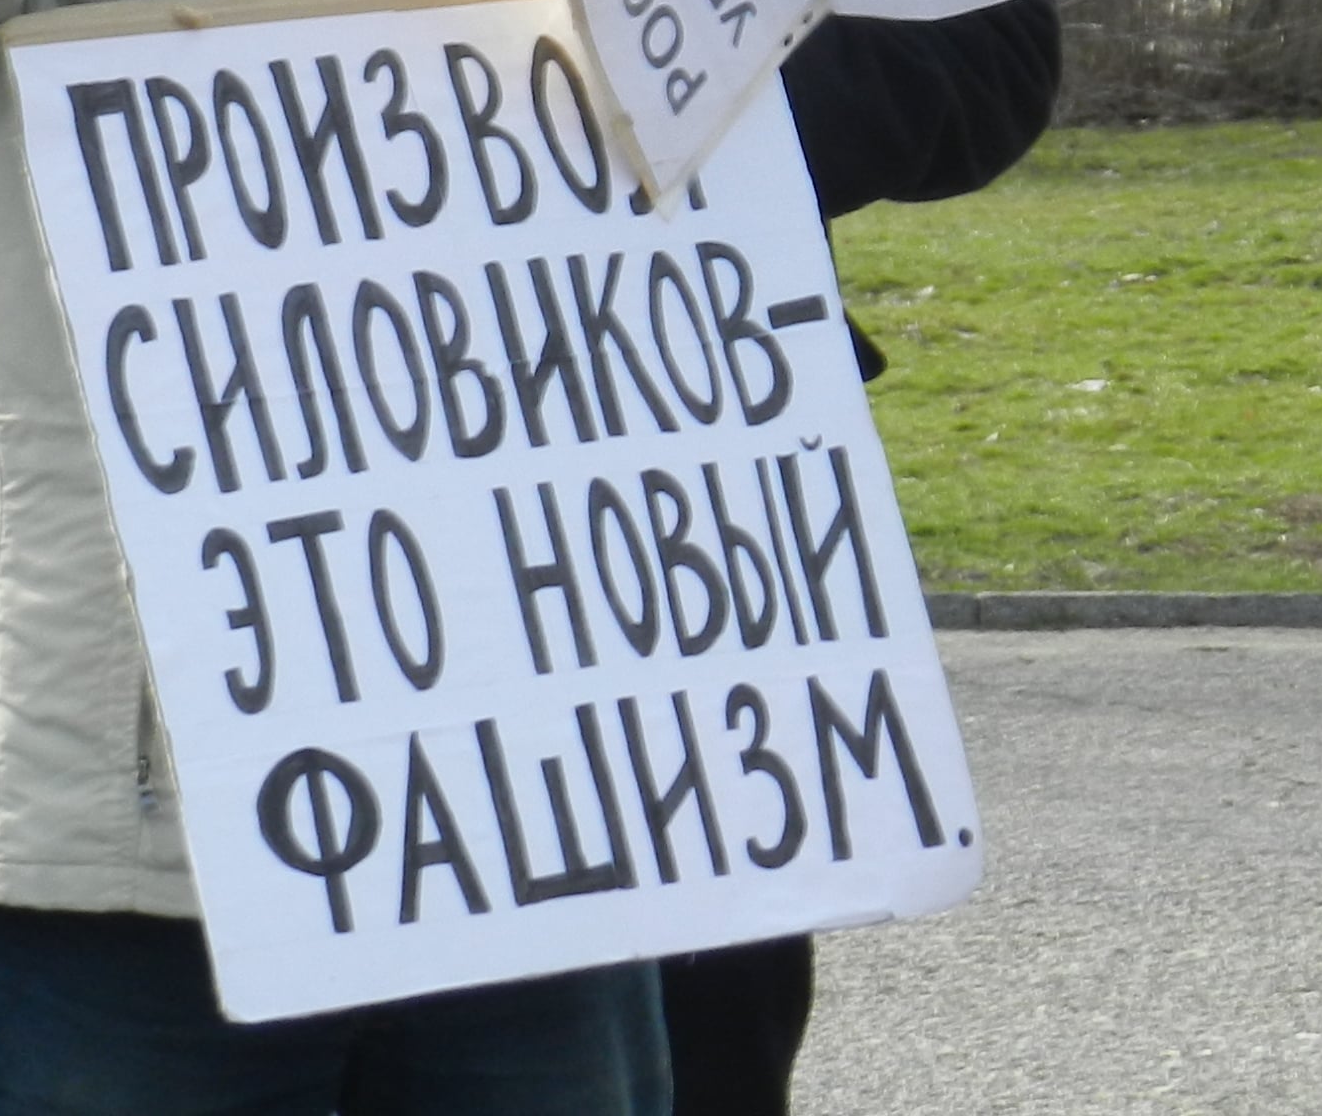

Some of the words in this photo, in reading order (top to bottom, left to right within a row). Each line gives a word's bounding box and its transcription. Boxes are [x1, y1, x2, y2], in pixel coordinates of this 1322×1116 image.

[67, 34, 709, 271] ПРОИЗВО
[105, 240, 829, 495] СИЛОВИКОВ-
[200, 508, 444, 715] ЭТО
[492, 434, 888, 675] НОВЫЙ
[255, 667, 975, 934] ФАШИЗМ.
